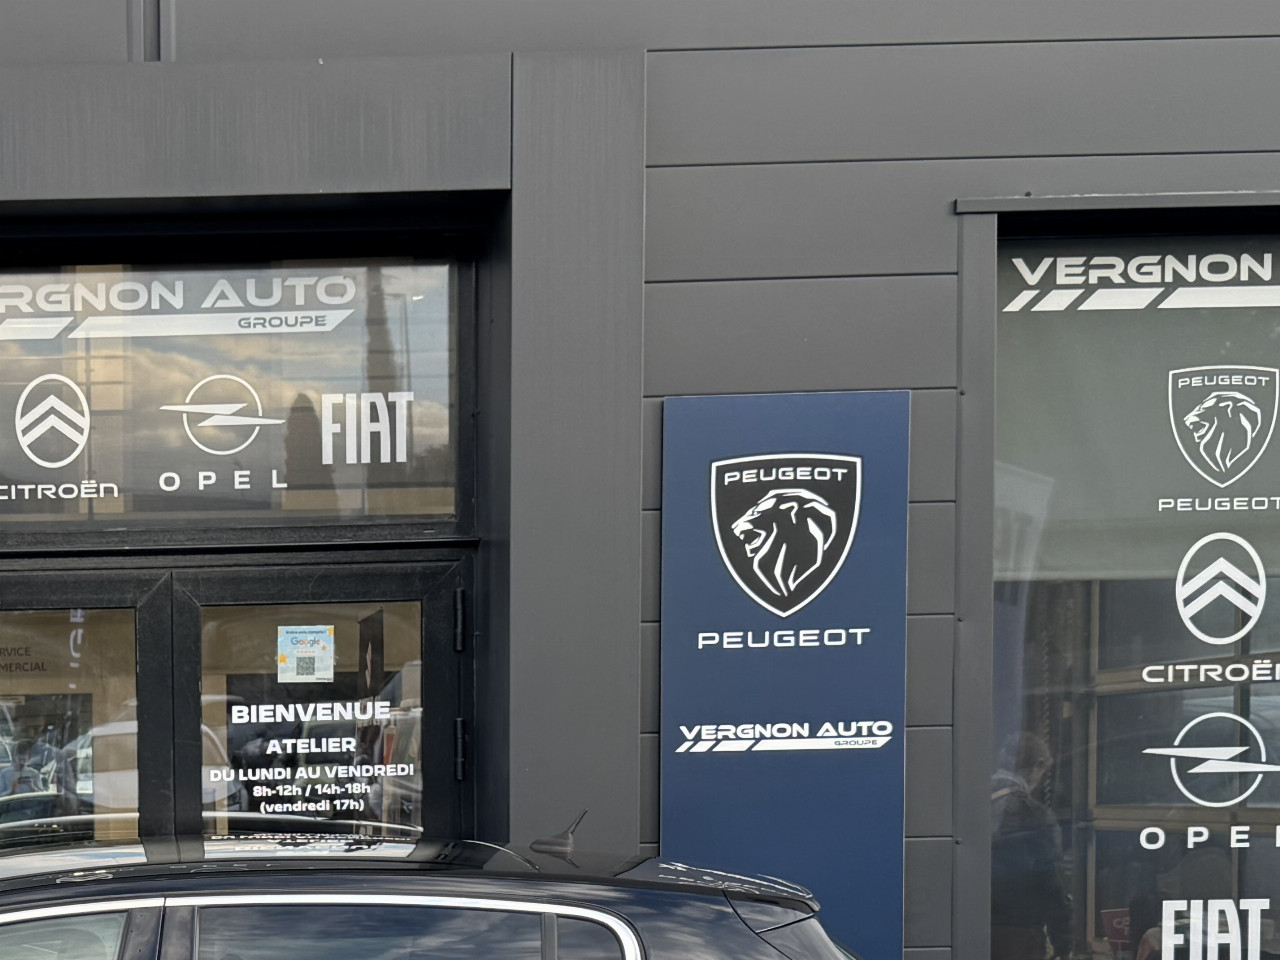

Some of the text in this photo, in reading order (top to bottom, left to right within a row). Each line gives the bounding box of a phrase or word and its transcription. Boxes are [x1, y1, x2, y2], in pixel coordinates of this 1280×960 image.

[1012, 253, 1272, 285] VERGNON
[201, 276, 356, 310] AUTO
[237, 315, 327, 329] GROUPE
[1177, 376, 1270, 388] PEUGEOT
[321, 392, 415, 465] FIAT
[158, 470, 288, 492] OPEL
[724, 467, 848, 486] PEUGEOT
[1158, 496, 1280, 511] PEUGEOT
[290, 636, 321, 647] Google
[697, 628, 871, 650] PEUGEOT
[231, 701, 391, 724] BIENVENUE
[679, 720, 893, 740] VERGNON AUTO
[265, 737, 357, 755] ATELIER
[209, 763, 414, 782] DU LUNDI AU VENDREDI
[252, 783, 370, 797] 8h-12h / 14h-18h
[259, 798, 365, 815] (vendredi 17h)
[1139, 825, 1280, 849] OPE
